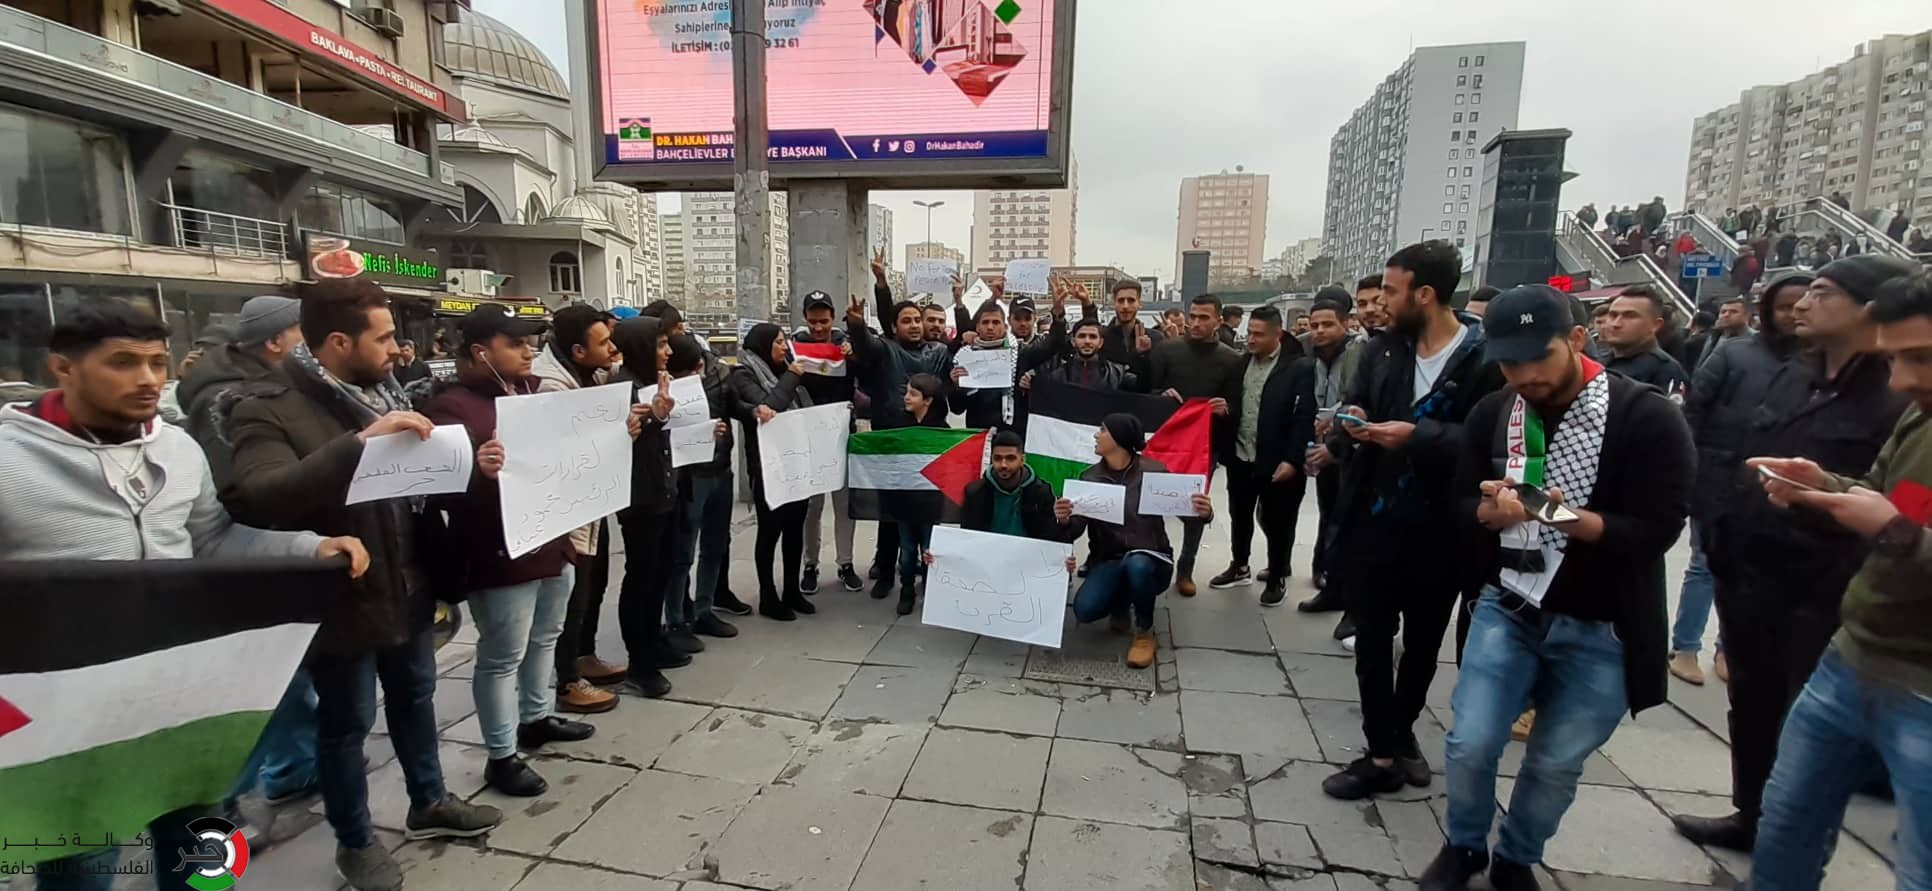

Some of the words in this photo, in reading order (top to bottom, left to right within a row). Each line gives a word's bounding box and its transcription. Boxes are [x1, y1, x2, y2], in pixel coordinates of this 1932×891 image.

[310, 31, 355, 62] BAKLAVA
[359, 55, 386, 77] PASTA
[674, 135, 710, 145] HAKAN
[656, 147, 729, 160] BAHÇELİEVLER
[781, 146, 827, 159] BAŞKANI
[363, 252, 391, 273] Nefis
[394, 252, 437, 278] İskender
[441, 300, 471, 313] MEYDAN
